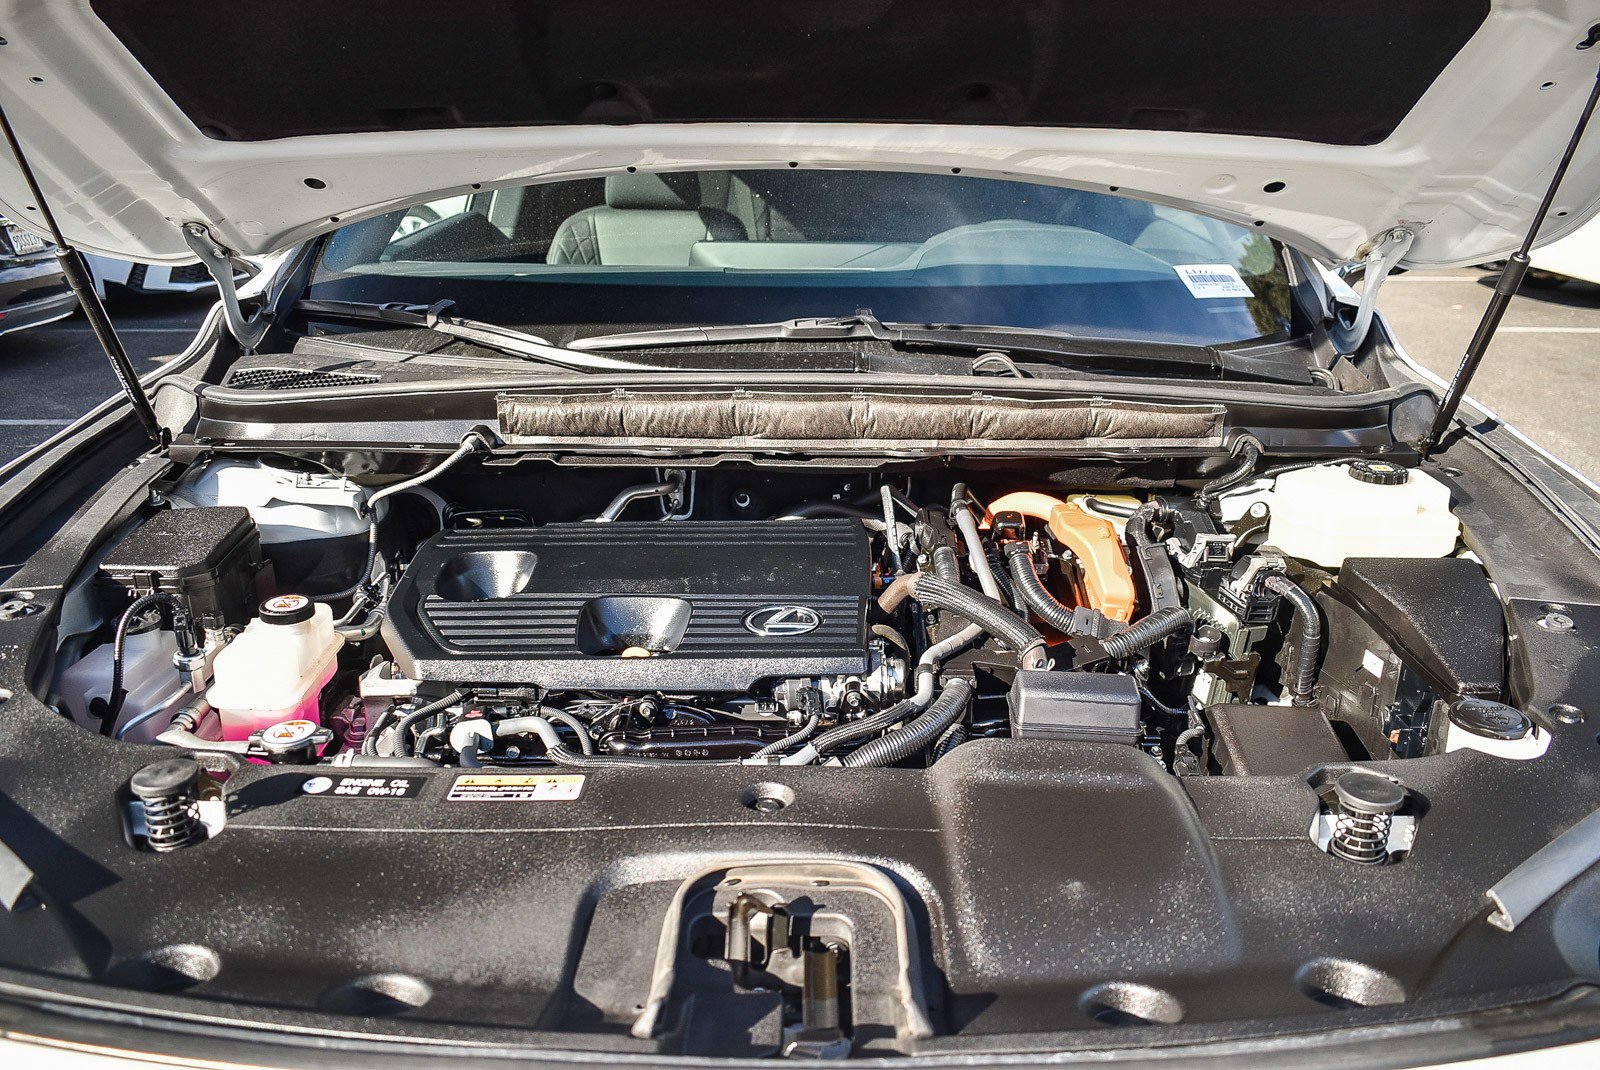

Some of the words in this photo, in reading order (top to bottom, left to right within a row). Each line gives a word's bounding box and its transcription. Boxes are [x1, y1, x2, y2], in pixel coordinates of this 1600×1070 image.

[340, 778, 386, 787] ENGINE
[390, 779, 410, 788] OIL
[334, 786, 362, 795] SAE
